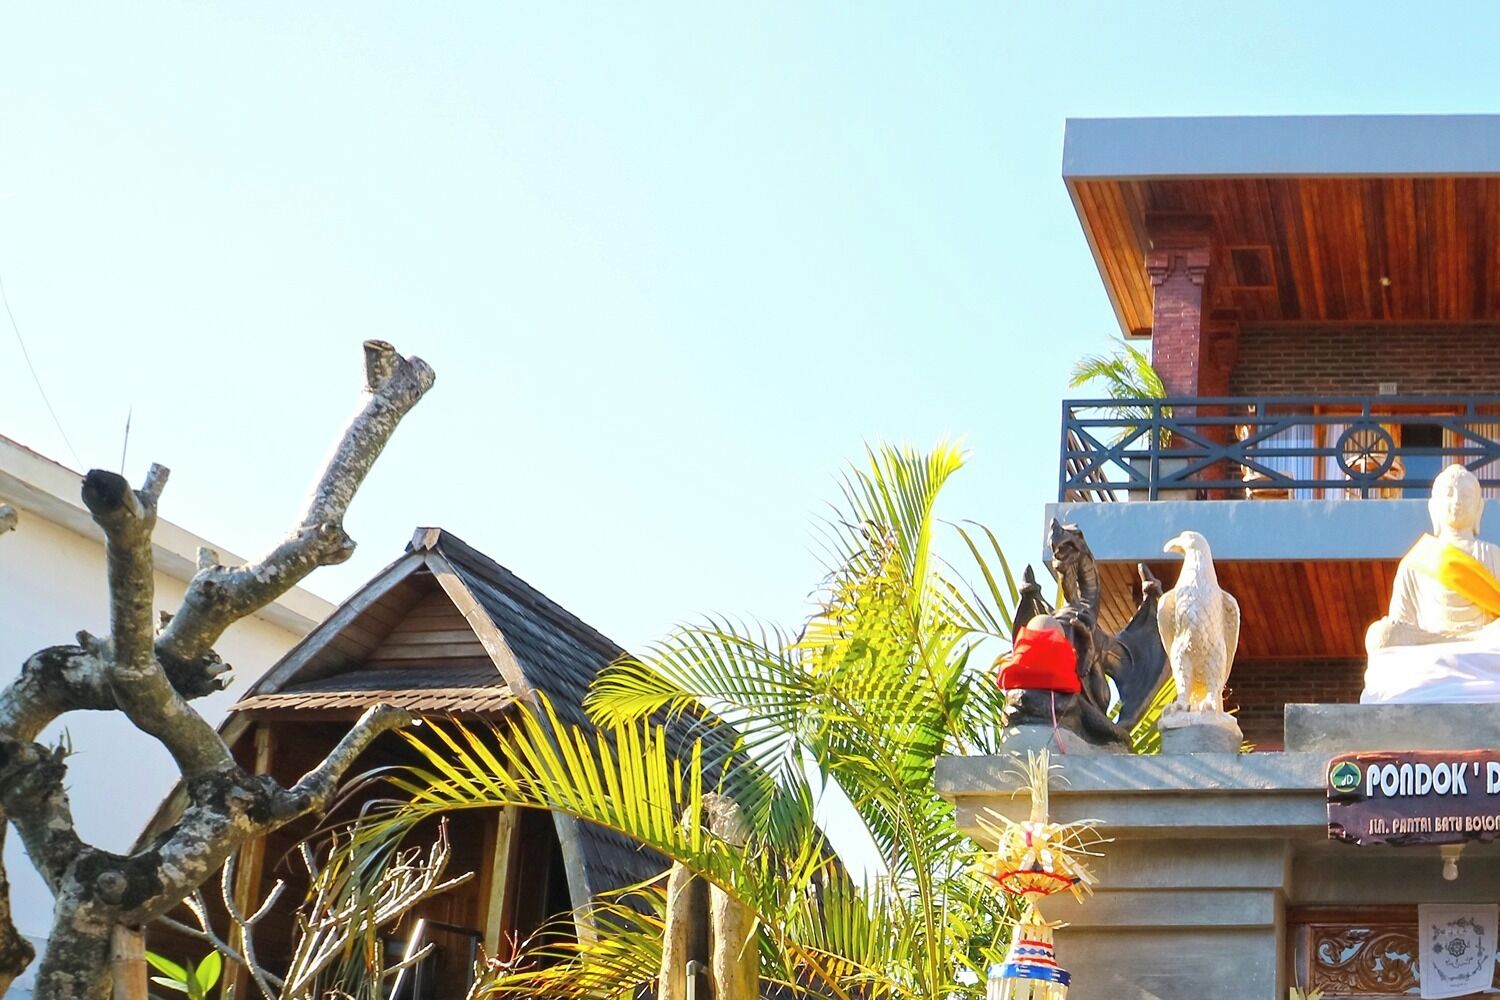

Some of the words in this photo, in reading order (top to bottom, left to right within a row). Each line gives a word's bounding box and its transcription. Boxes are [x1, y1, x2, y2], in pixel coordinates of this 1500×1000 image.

[1366, 762, 1468, 797] PONDOK
[1392, 816, 1432, 834] PANTAI
[1434, 816, 1463, 833] BATU
